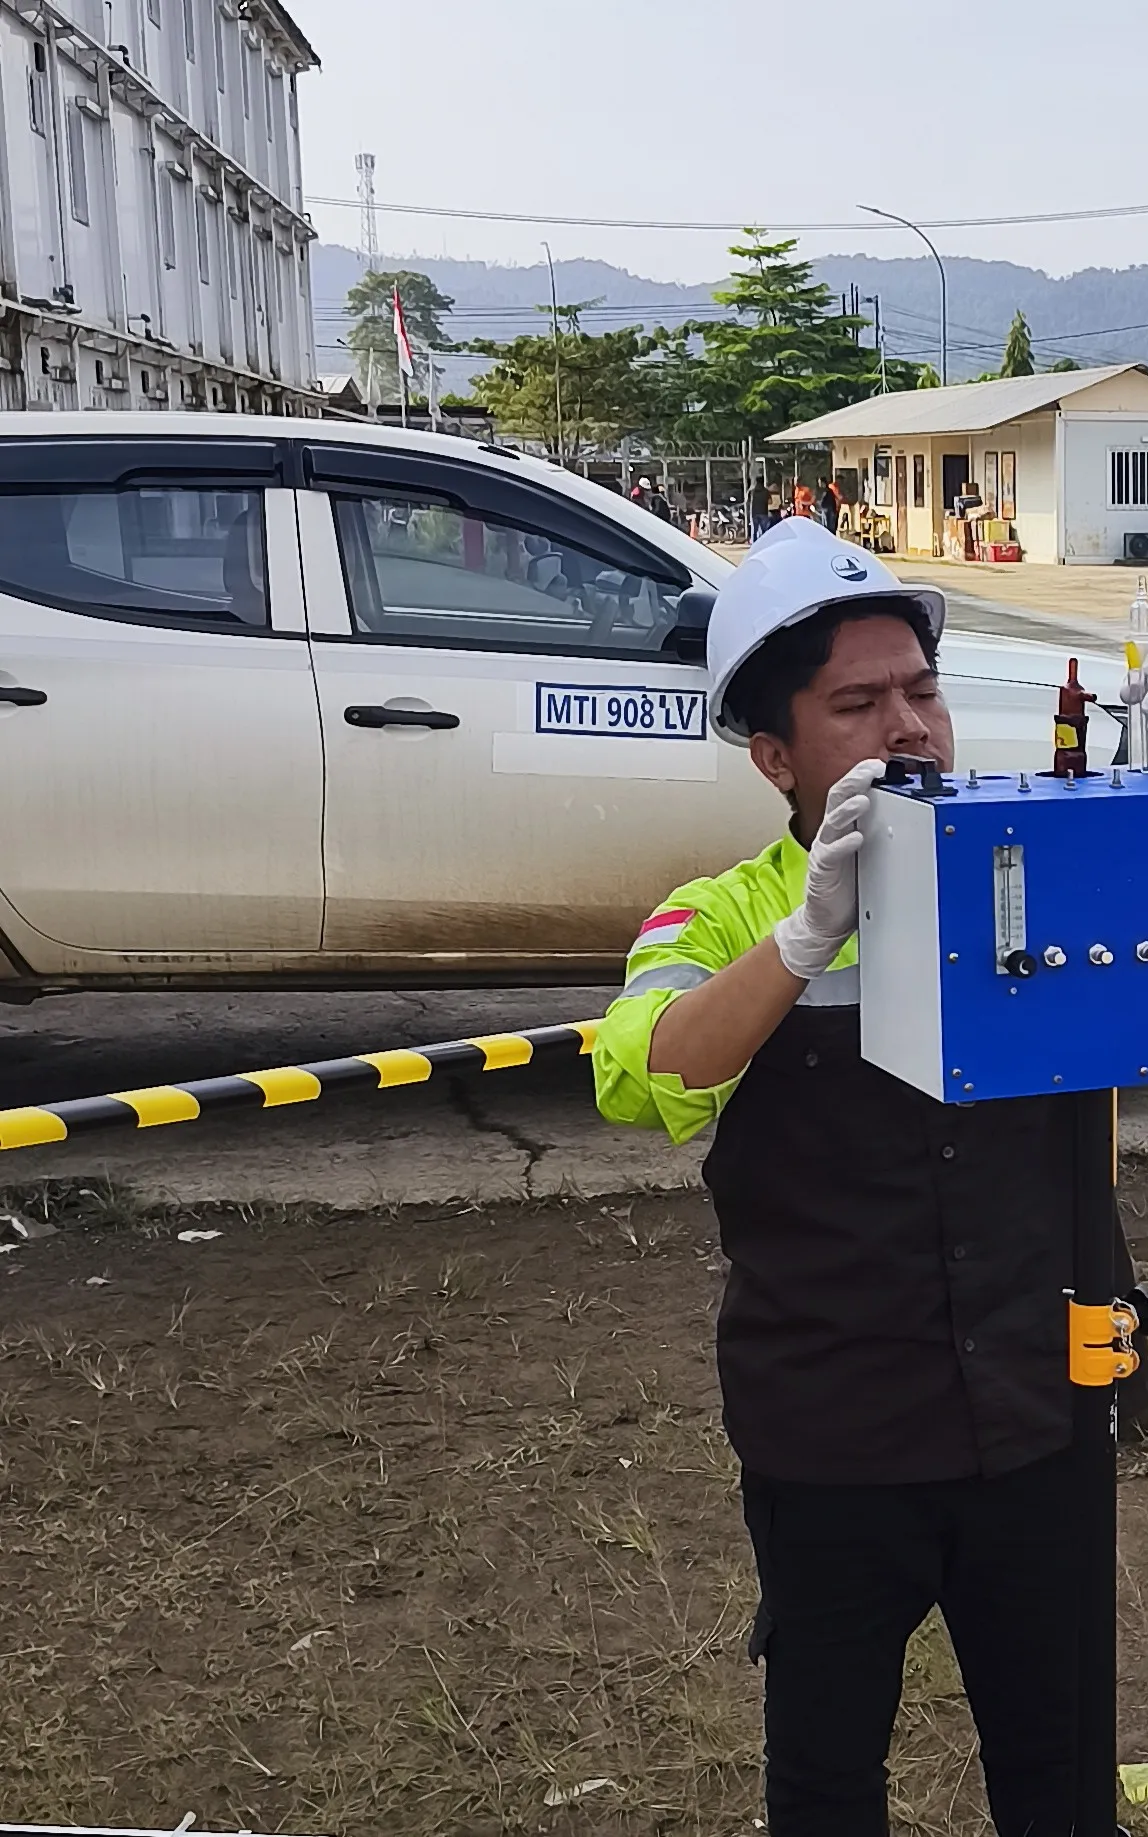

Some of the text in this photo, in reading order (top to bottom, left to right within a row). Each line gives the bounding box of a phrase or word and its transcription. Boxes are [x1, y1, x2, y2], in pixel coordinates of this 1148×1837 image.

[547, 693, 699, 730] MTI 908 LV
